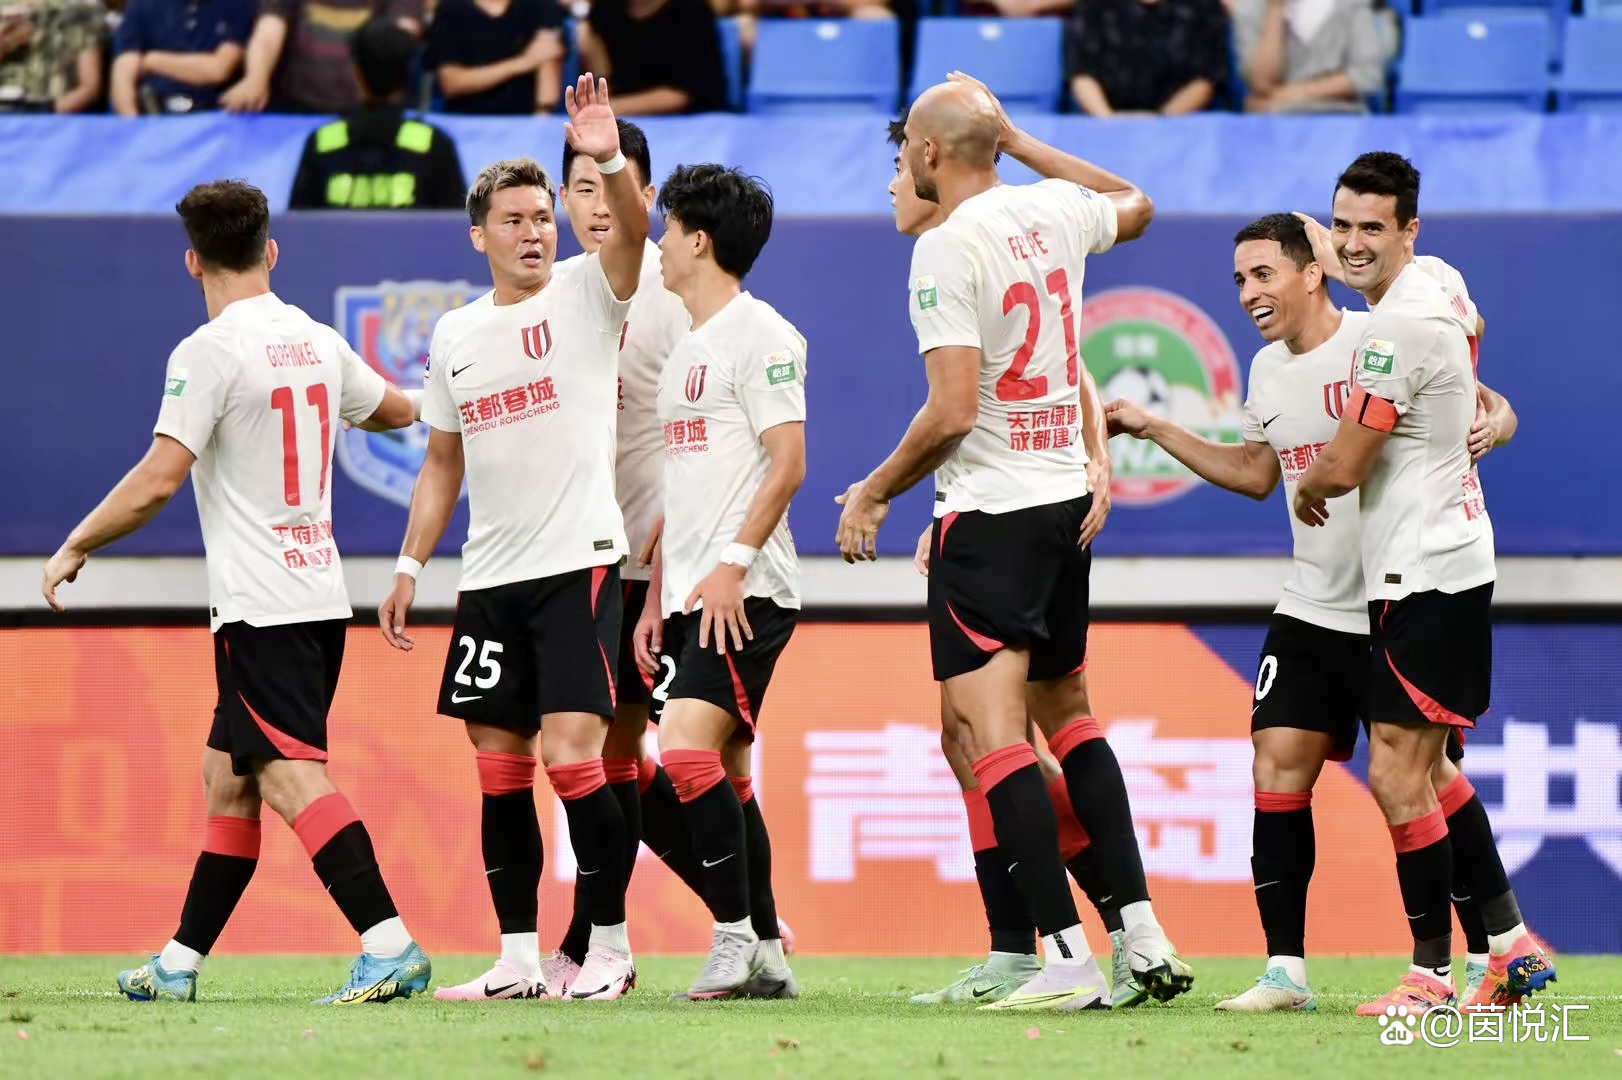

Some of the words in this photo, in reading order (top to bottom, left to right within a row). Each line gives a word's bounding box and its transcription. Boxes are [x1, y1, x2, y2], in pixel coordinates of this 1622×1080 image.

[1007, 231, 1049, 261] FELPE
[996, 268, 1078, 402] 21
[459, 376, 557, 425] 成都蓉城
[500, 401, 561, 426] RONGCHENG
[1007, 404, 1078, 430] 天府绿道
[271, 383, 330, 507] 11
[454, 635, 503, 689] 25
